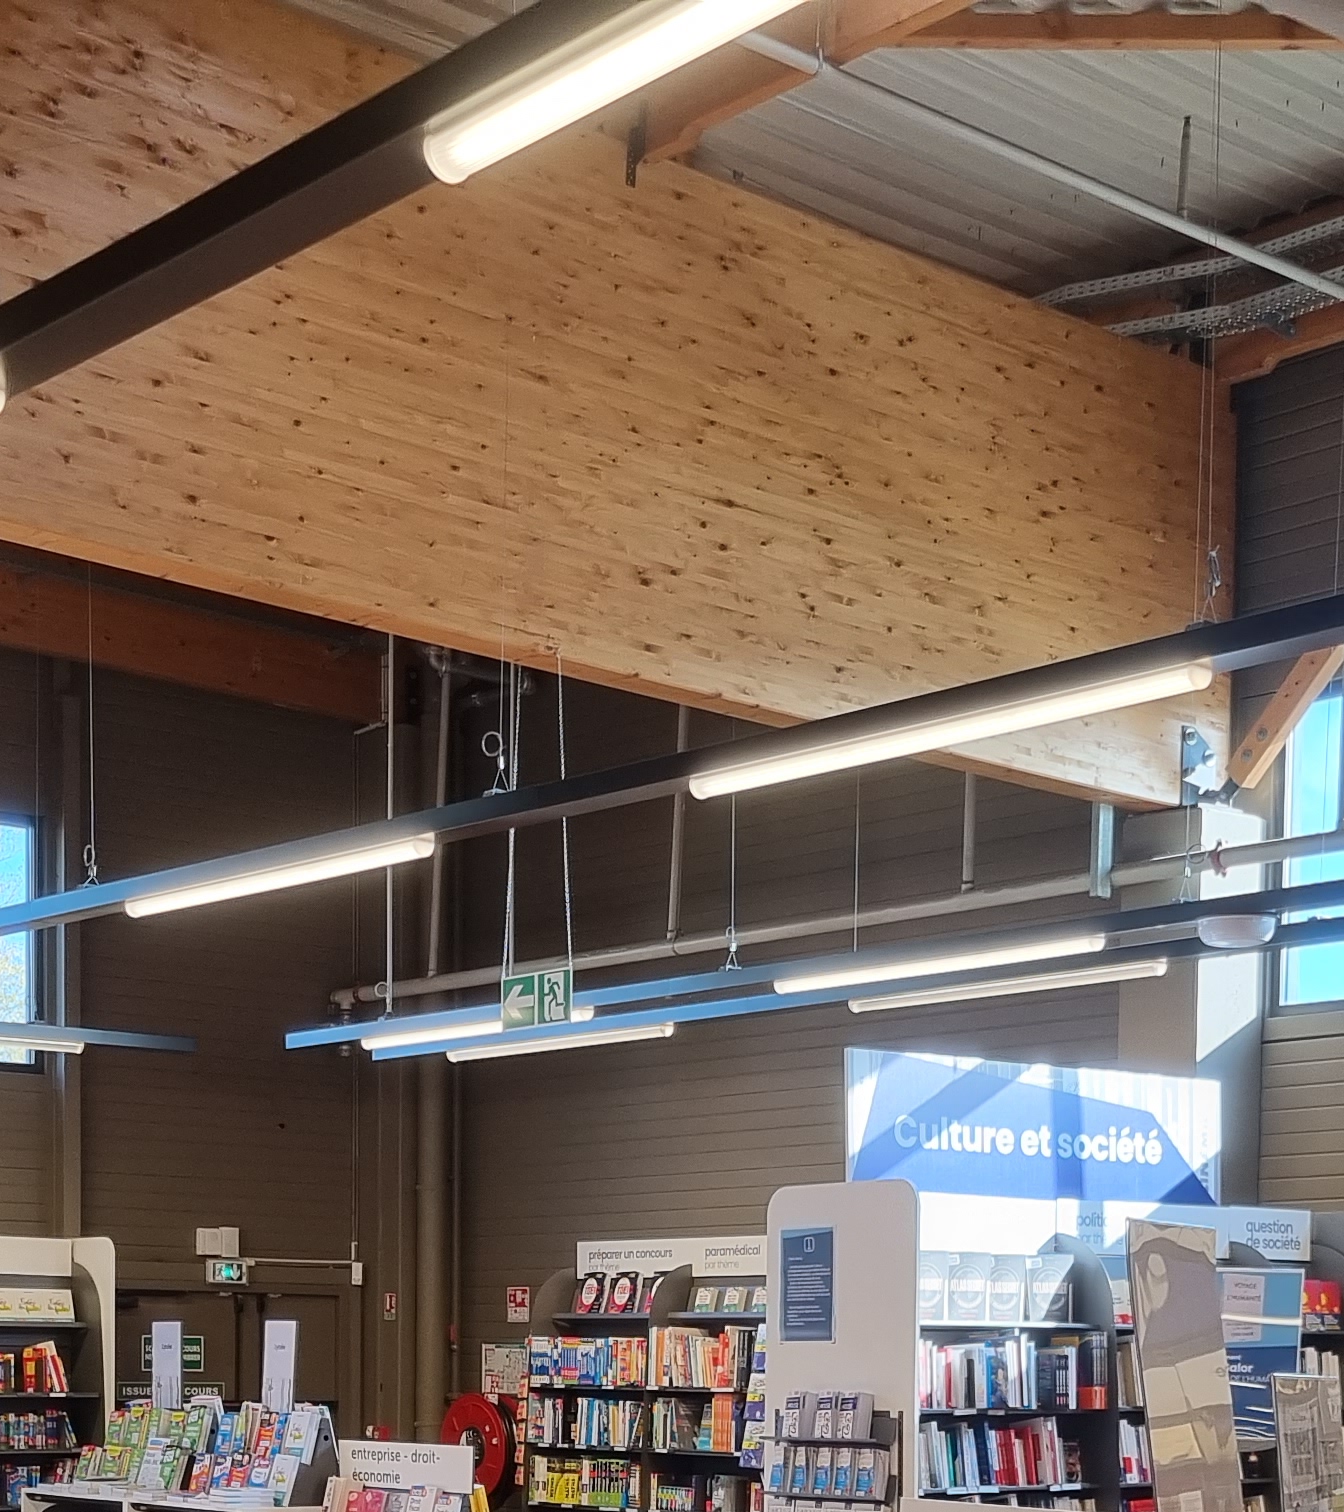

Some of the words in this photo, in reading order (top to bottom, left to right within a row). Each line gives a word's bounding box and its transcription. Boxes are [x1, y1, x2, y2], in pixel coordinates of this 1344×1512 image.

[893, 1114, 1014, 1155] Culture
[1020, 1124, 1052, 1156] et
[1057, 1125, 1163, 1165] société
[1246, 1219, 1293, 1236] question
[1246, 1235, 1260, 1249] de
[1262, 1235, 1301, 1251] société
[588, 1249, 622, 1263] préparer
[624, 1250, 635, 1259] un
[636, 1248, 673, 1259] concours
[705, 1245, 761, 1259] paramédical
[122, 1386, 152, 1396] ISSUE
[351, 1448, 401, 1464] entreprise
[352, 1469, 401, 1485] économie
